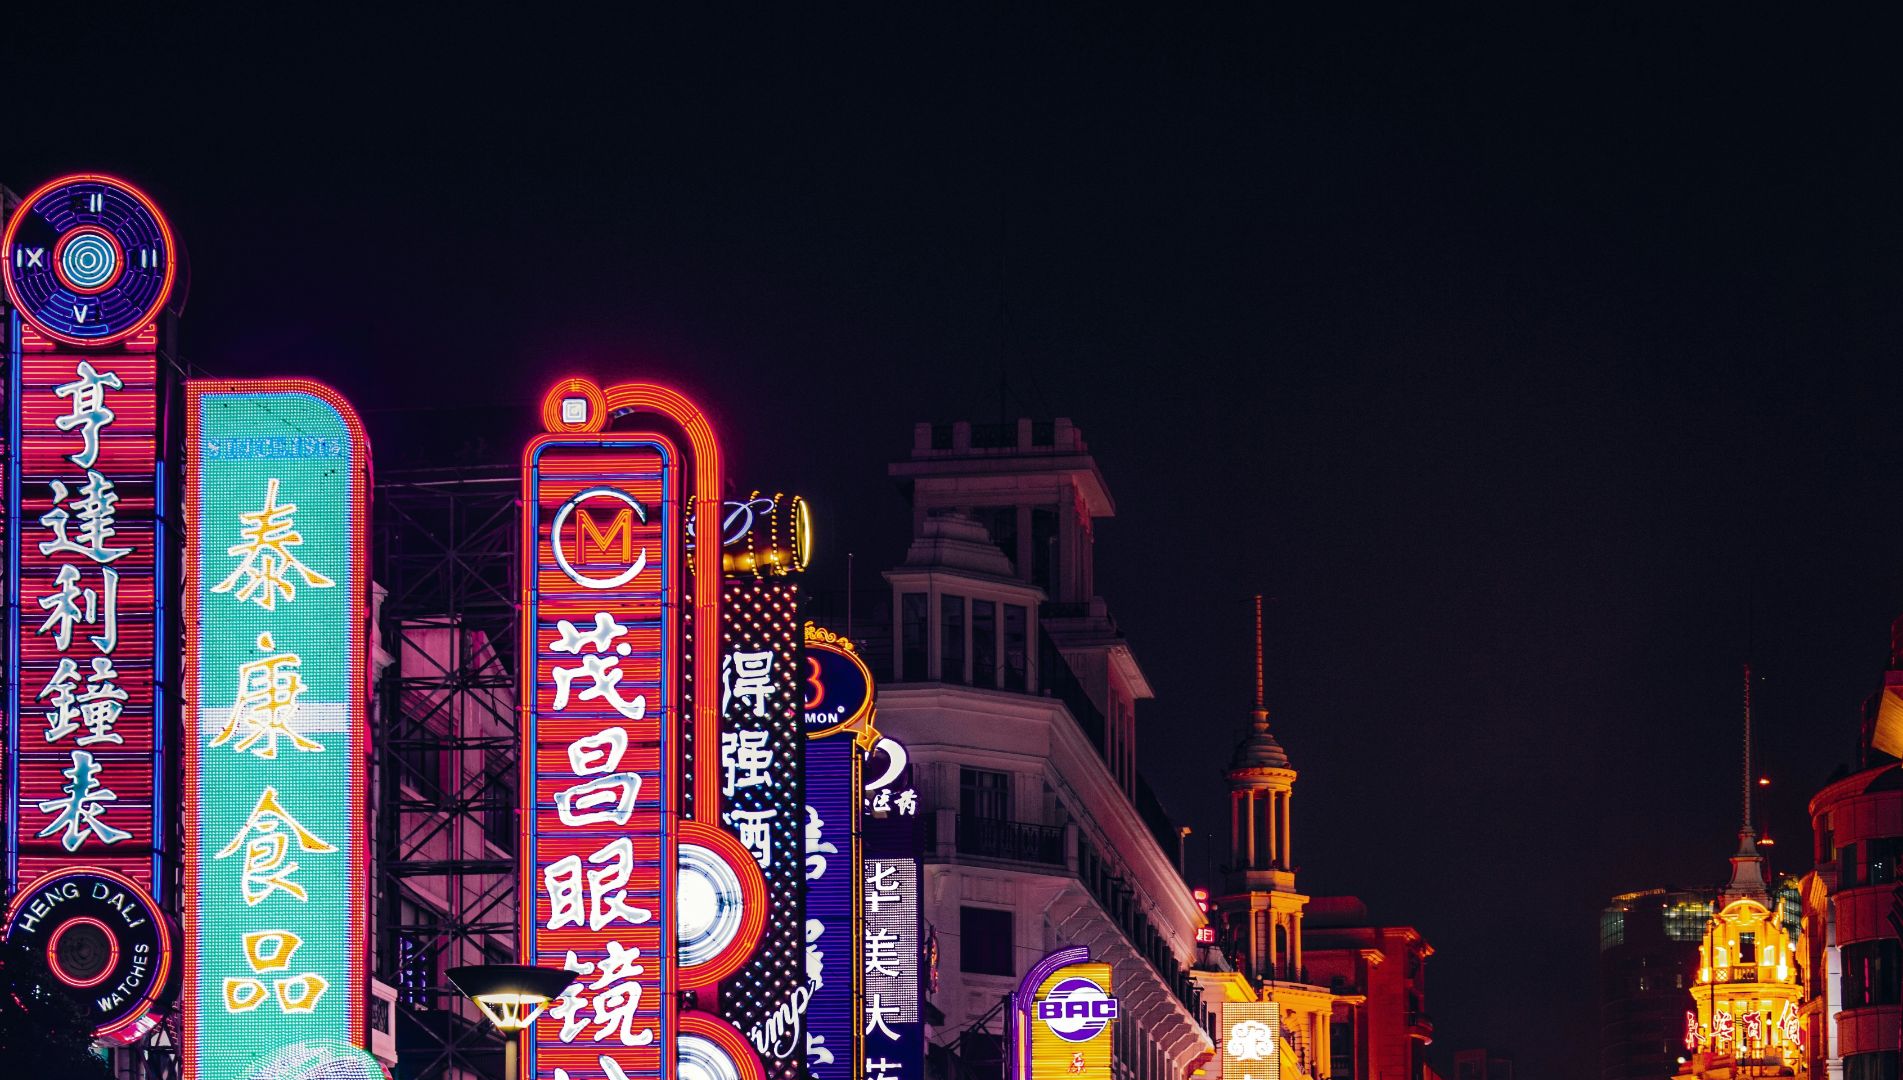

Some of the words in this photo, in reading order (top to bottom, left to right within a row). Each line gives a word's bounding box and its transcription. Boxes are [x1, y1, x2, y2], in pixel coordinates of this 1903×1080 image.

[209, 478, 339, 1012] 泰康食品
[18, 882, 81, 933] HENG
[91, 882, 146, 928] DALI
[97, 943, 149, 1012] WATCHES
[1039, 1001, 1117, 1019] BAC
